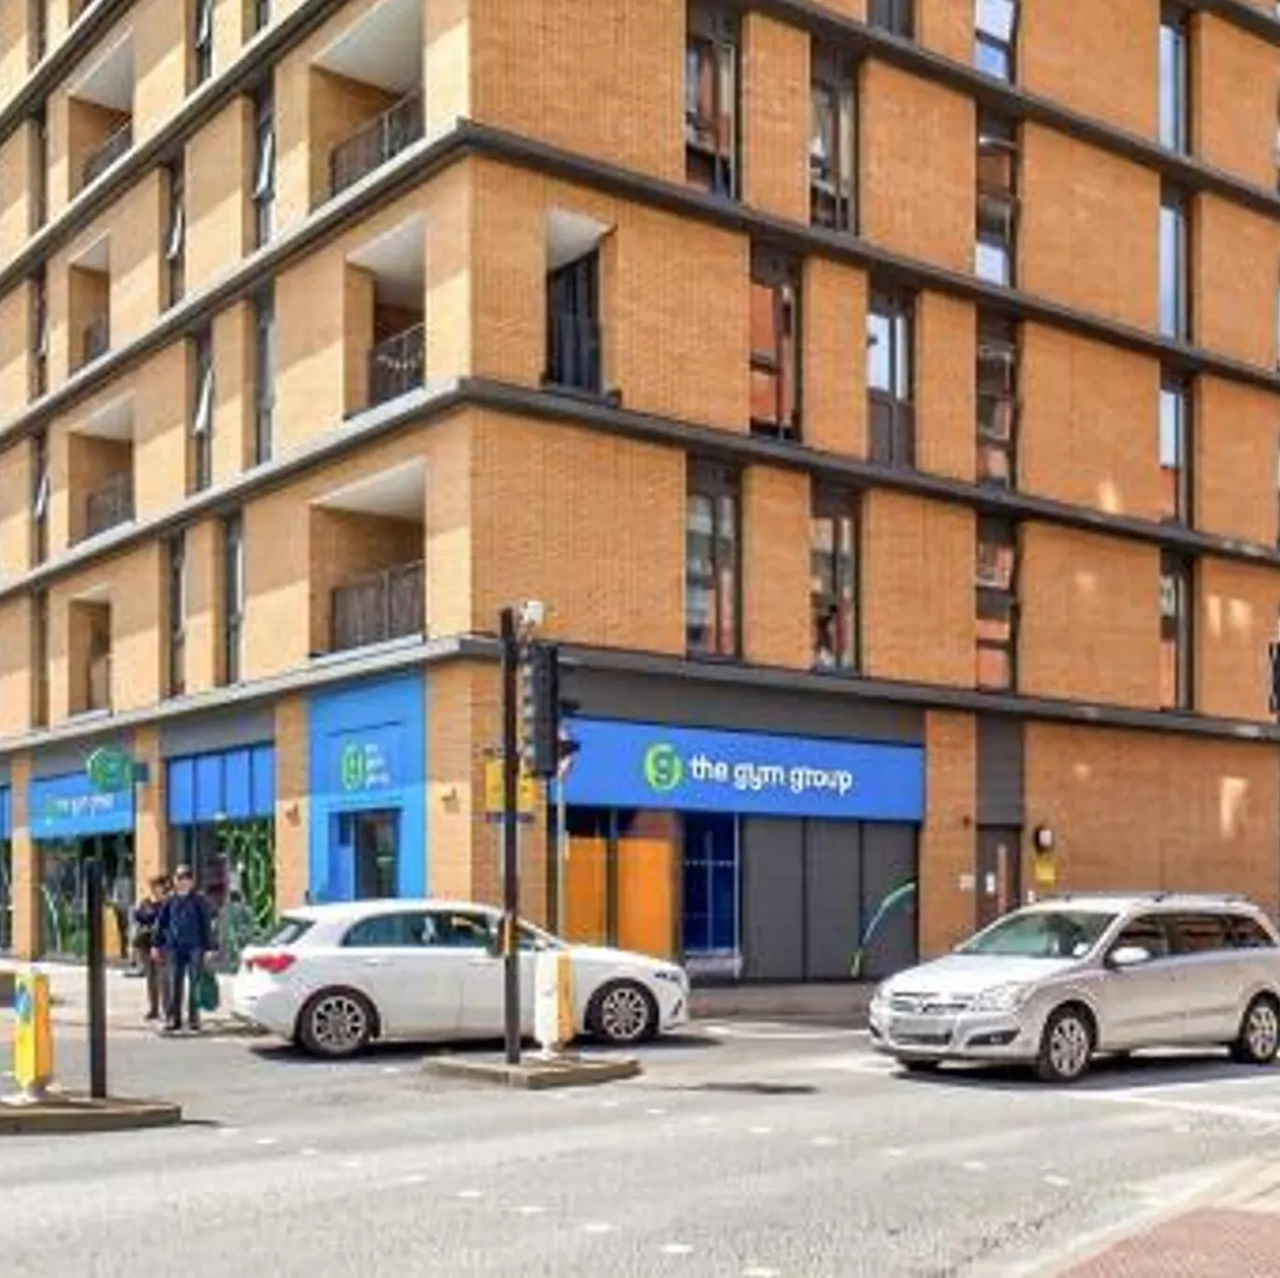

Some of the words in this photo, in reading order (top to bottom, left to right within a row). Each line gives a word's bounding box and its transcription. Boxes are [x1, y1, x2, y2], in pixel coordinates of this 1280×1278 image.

[690, 753, 729, 782] the
[733, 761, 786, 791] gym
[789, 765, 853, 796] group
